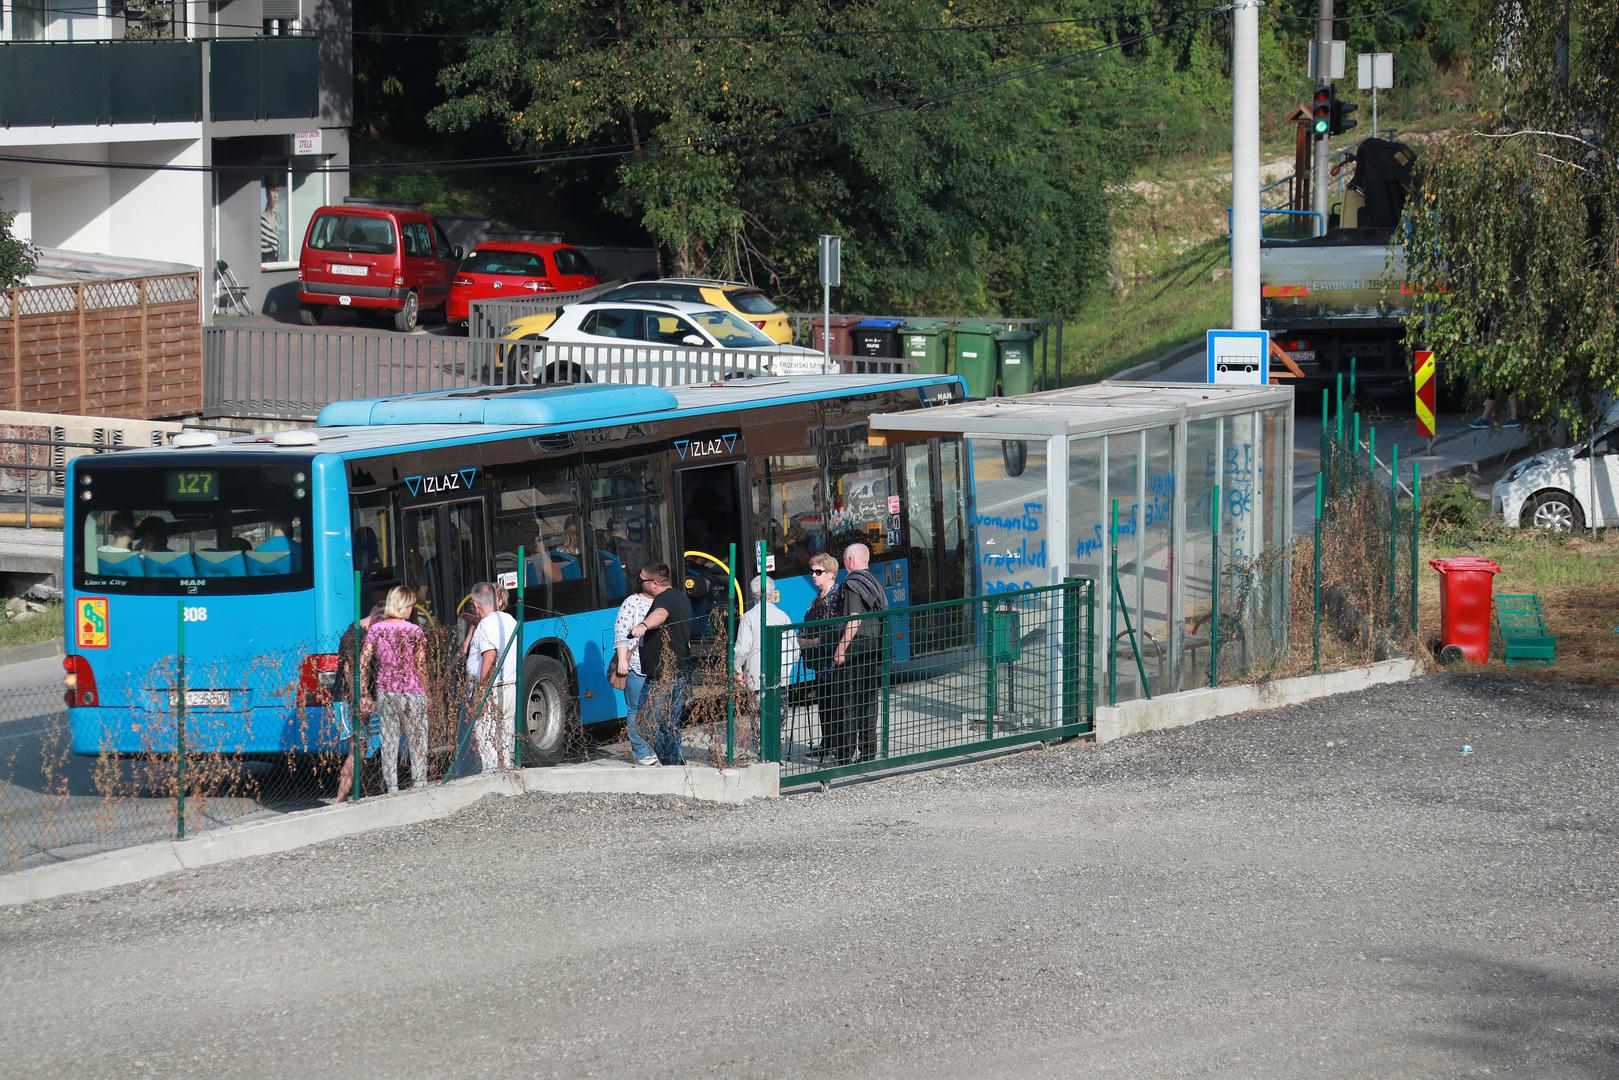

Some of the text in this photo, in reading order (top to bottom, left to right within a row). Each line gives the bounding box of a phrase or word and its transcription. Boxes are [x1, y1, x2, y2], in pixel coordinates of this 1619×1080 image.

[937, 392, 952, 401] MAN
[690, 439, 722, 457] IZLAZ
[178, 473, 212, 494] 127
[423, 473, 460, 493] IZLAZ
[109, 579, 128, 587] City
[893, 588, 905, 602] 308
